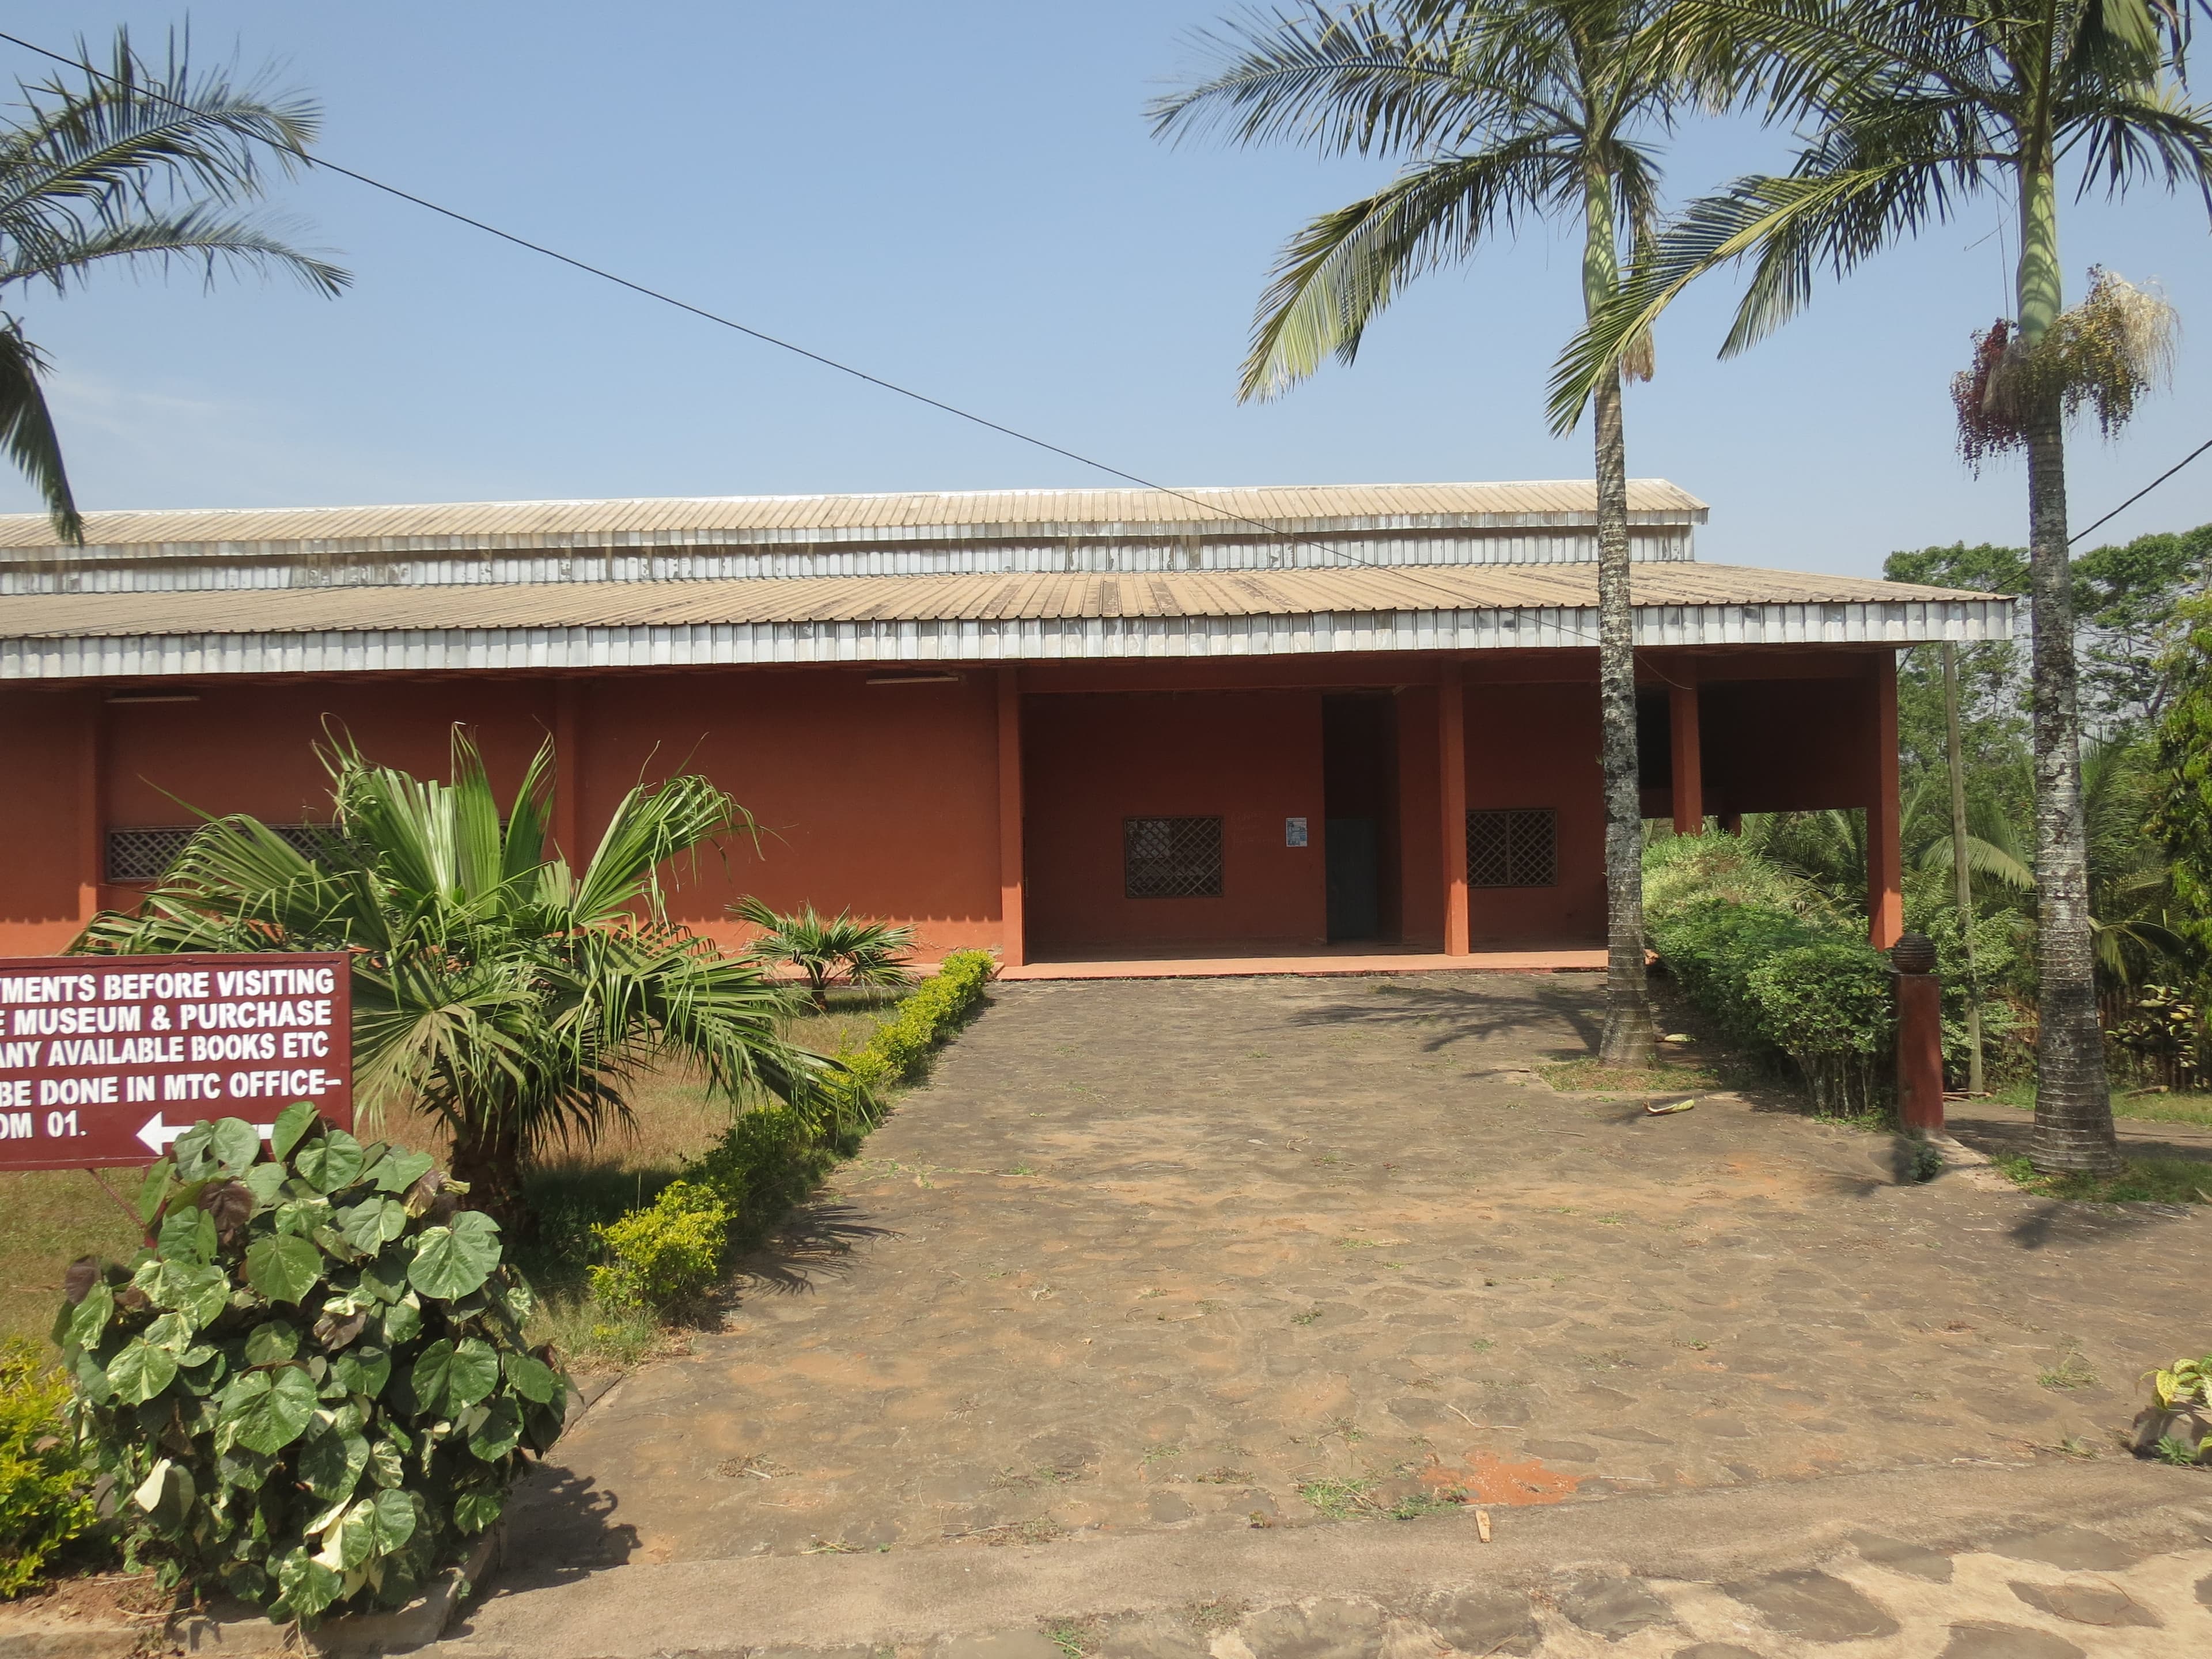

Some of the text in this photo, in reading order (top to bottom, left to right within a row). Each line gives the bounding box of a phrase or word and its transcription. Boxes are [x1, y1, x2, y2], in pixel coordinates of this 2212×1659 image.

[0, 968, 334, 1003] MENTS BEFORE VISITING
[14, 1005, 141, 1036] MUSEUM
[150, 1005, 172, 1031] &
[180, 999, 332, 1030] PURCHASE
[47, 1036, 184, 1067] AVAILABLE
[191, 1032, 276, 1062] BOOKS
[283, 1031, 329, 1058] ETC
[0, 1080, 32, 1107] BE
[40, 1076, 119, 1105] DONE
[127, 1075, 156, 1102] IN
[164, 1073, 221, 1100] MTC
[47, 1110, 87, 1137] 01.
